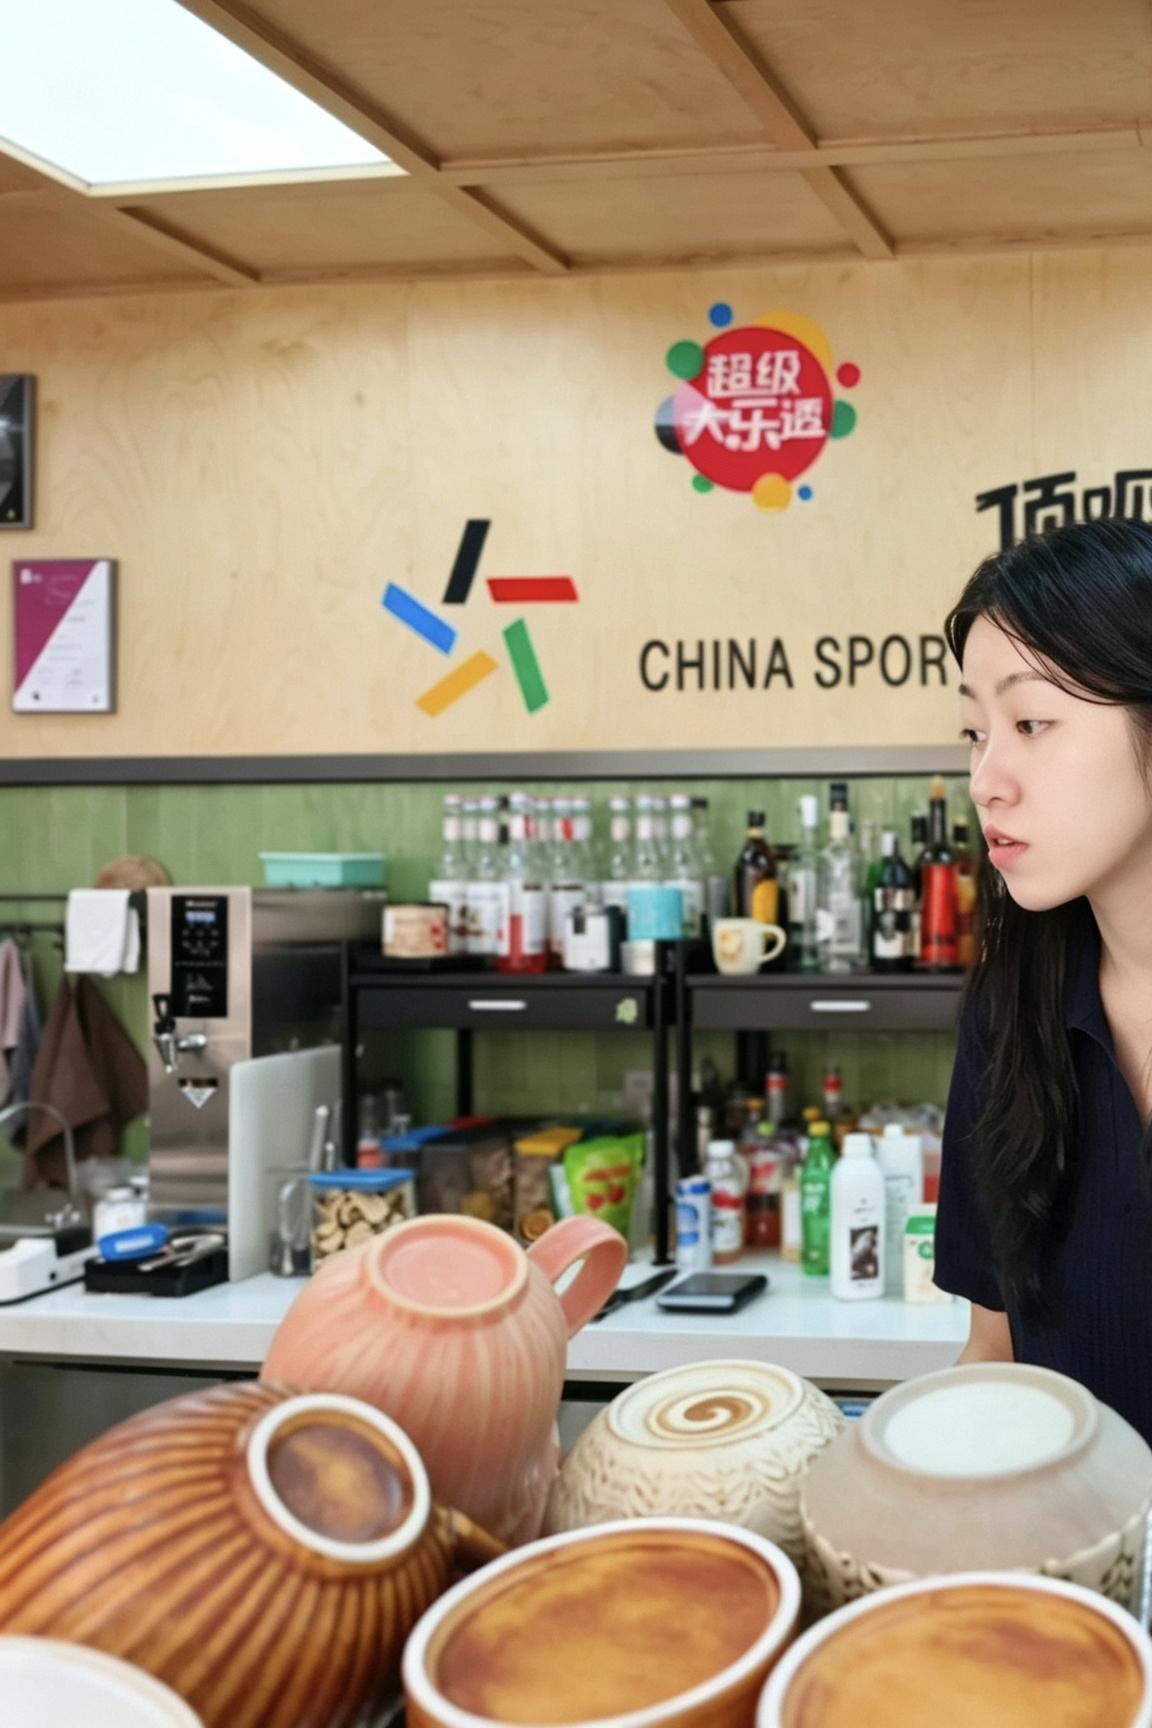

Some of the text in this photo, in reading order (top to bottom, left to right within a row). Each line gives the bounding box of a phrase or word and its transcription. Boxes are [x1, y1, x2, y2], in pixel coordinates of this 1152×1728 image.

[707, 350, 800, 398] 超级
[682, 397, 826, 451] 大乐透
[639, 633, 948, 692] CHINA SPOR
